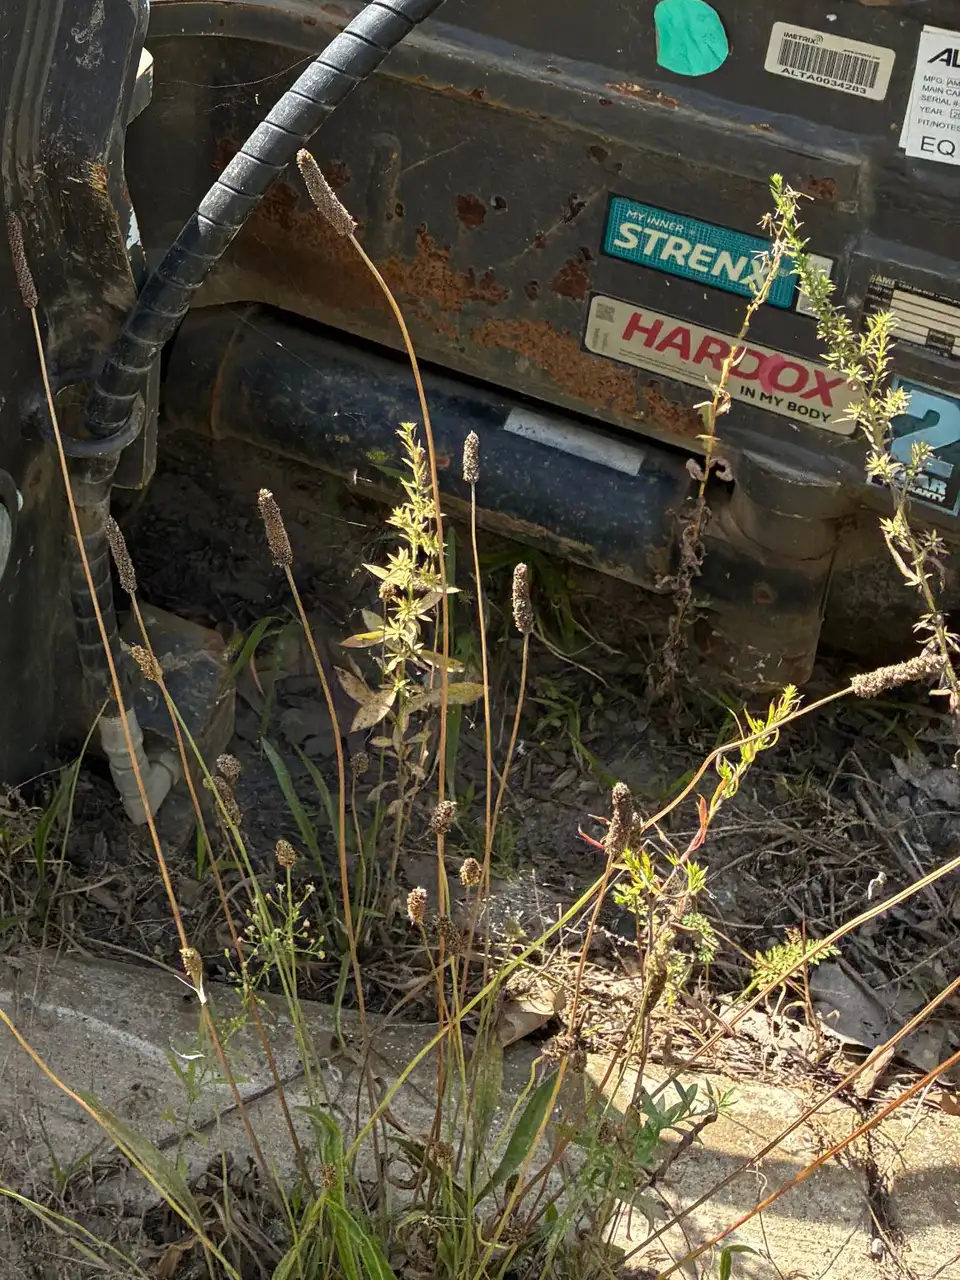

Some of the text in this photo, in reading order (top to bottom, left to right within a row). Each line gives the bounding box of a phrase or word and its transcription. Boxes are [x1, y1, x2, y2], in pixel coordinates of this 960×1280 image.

[921, 95, 951, 106] SERIAL
[922, 85, 944, 94] MAIN
[920, 136, 956, 158] EQ
[626, 209, 685, 232] MY INNER
[614, 222, 774, 290] STRENX
[621, 311, 846, 408] HARDOX
[740, 385, 831, 423] IN MY BODY
[891, 389, 960, 479] 2
